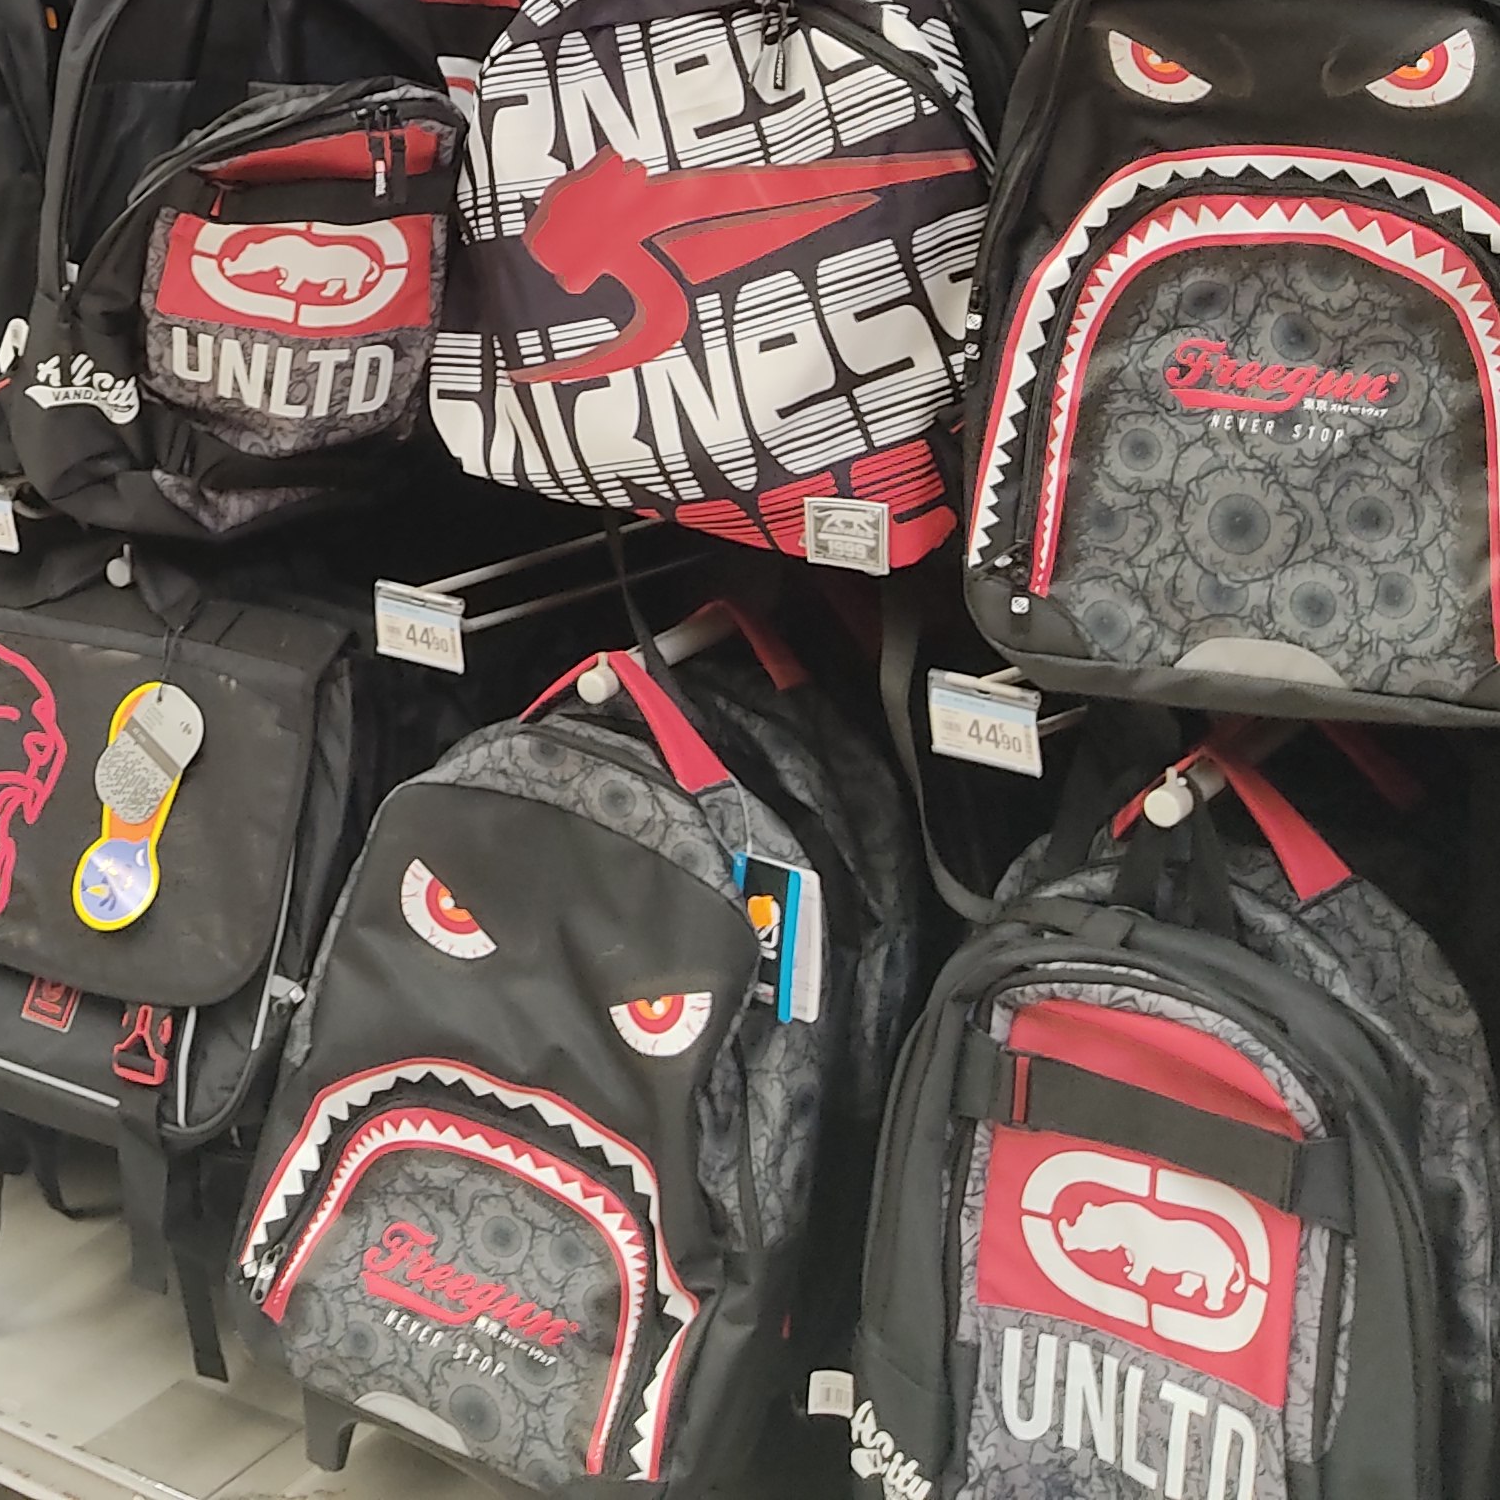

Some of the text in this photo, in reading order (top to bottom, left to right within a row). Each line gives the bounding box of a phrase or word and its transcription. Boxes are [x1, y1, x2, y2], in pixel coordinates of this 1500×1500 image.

[172, 327, 396, 420] UNLTD
[1210, 413, 1346, 442] NEVER STOP
[383, 1308, 508, 1379] NEVER STOP
[1001, 1328, 1261, 1500] UNLTD
